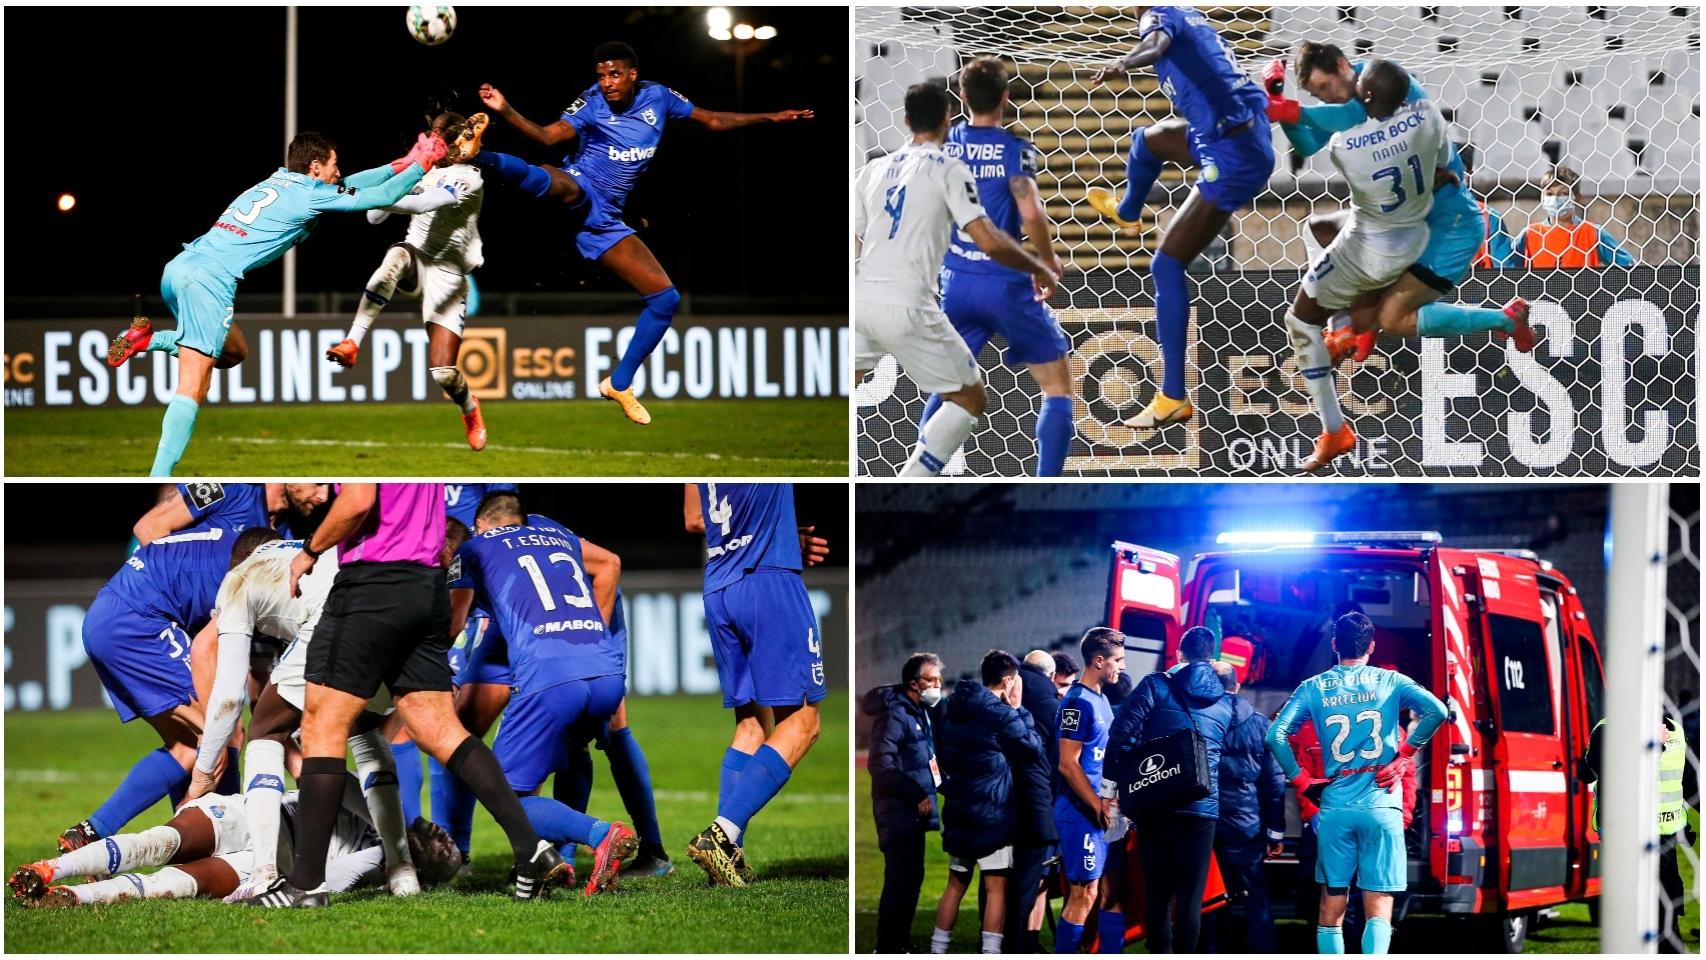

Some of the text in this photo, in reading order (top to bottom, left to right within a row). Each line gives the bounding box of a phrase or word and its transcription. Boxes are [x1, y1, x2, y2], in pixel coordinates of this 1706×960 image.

[1346, 111, 1425, 150] SUPER BOCK
[608, 145, 657, 162] betwa
[966, 144, 1005, 160] VIBE
[1371, 154, 1425, 213] 31
[512, 347, 576, 378] ESC
[512, 380, 576, 400] ONLINE
[1421, 298, 1700, 468] ESC
[517, 552, 593, 611] 13
[545, 619, 604, 633] MABOR
[1325, 710, 1384, 763] 23
[1128, 763, 1181, 794] Lacatoni
[1083, 834, 1095, 854] 4
